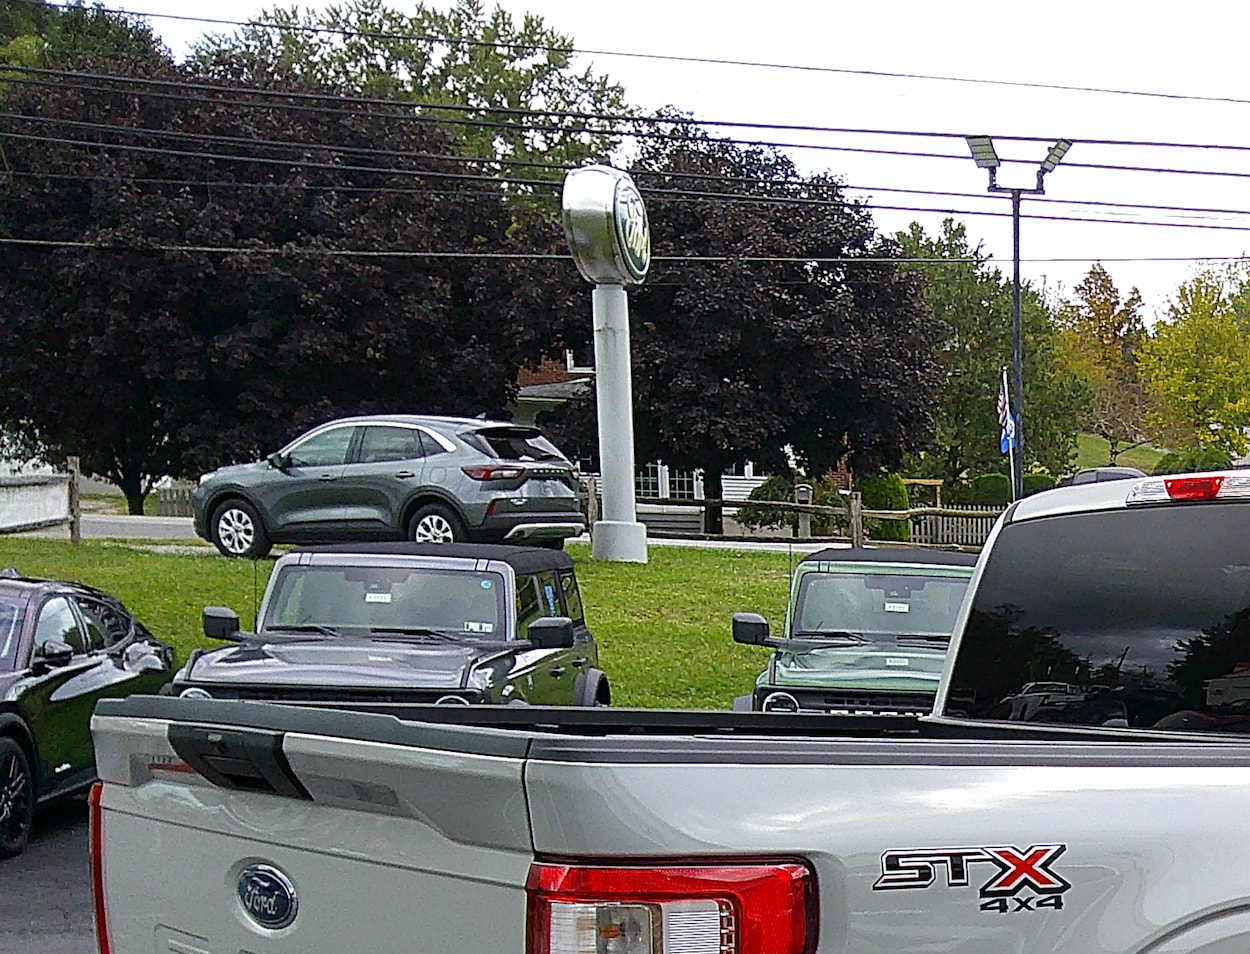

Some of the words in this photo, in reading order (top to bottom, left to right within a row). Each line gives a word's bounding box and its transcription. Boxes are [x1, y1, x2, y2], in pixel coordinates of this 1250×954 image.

[873, 844, 1071, 898] STX
[244, 876, 278, 915] Ford
[979, 896, 1063, 913] 4x4
